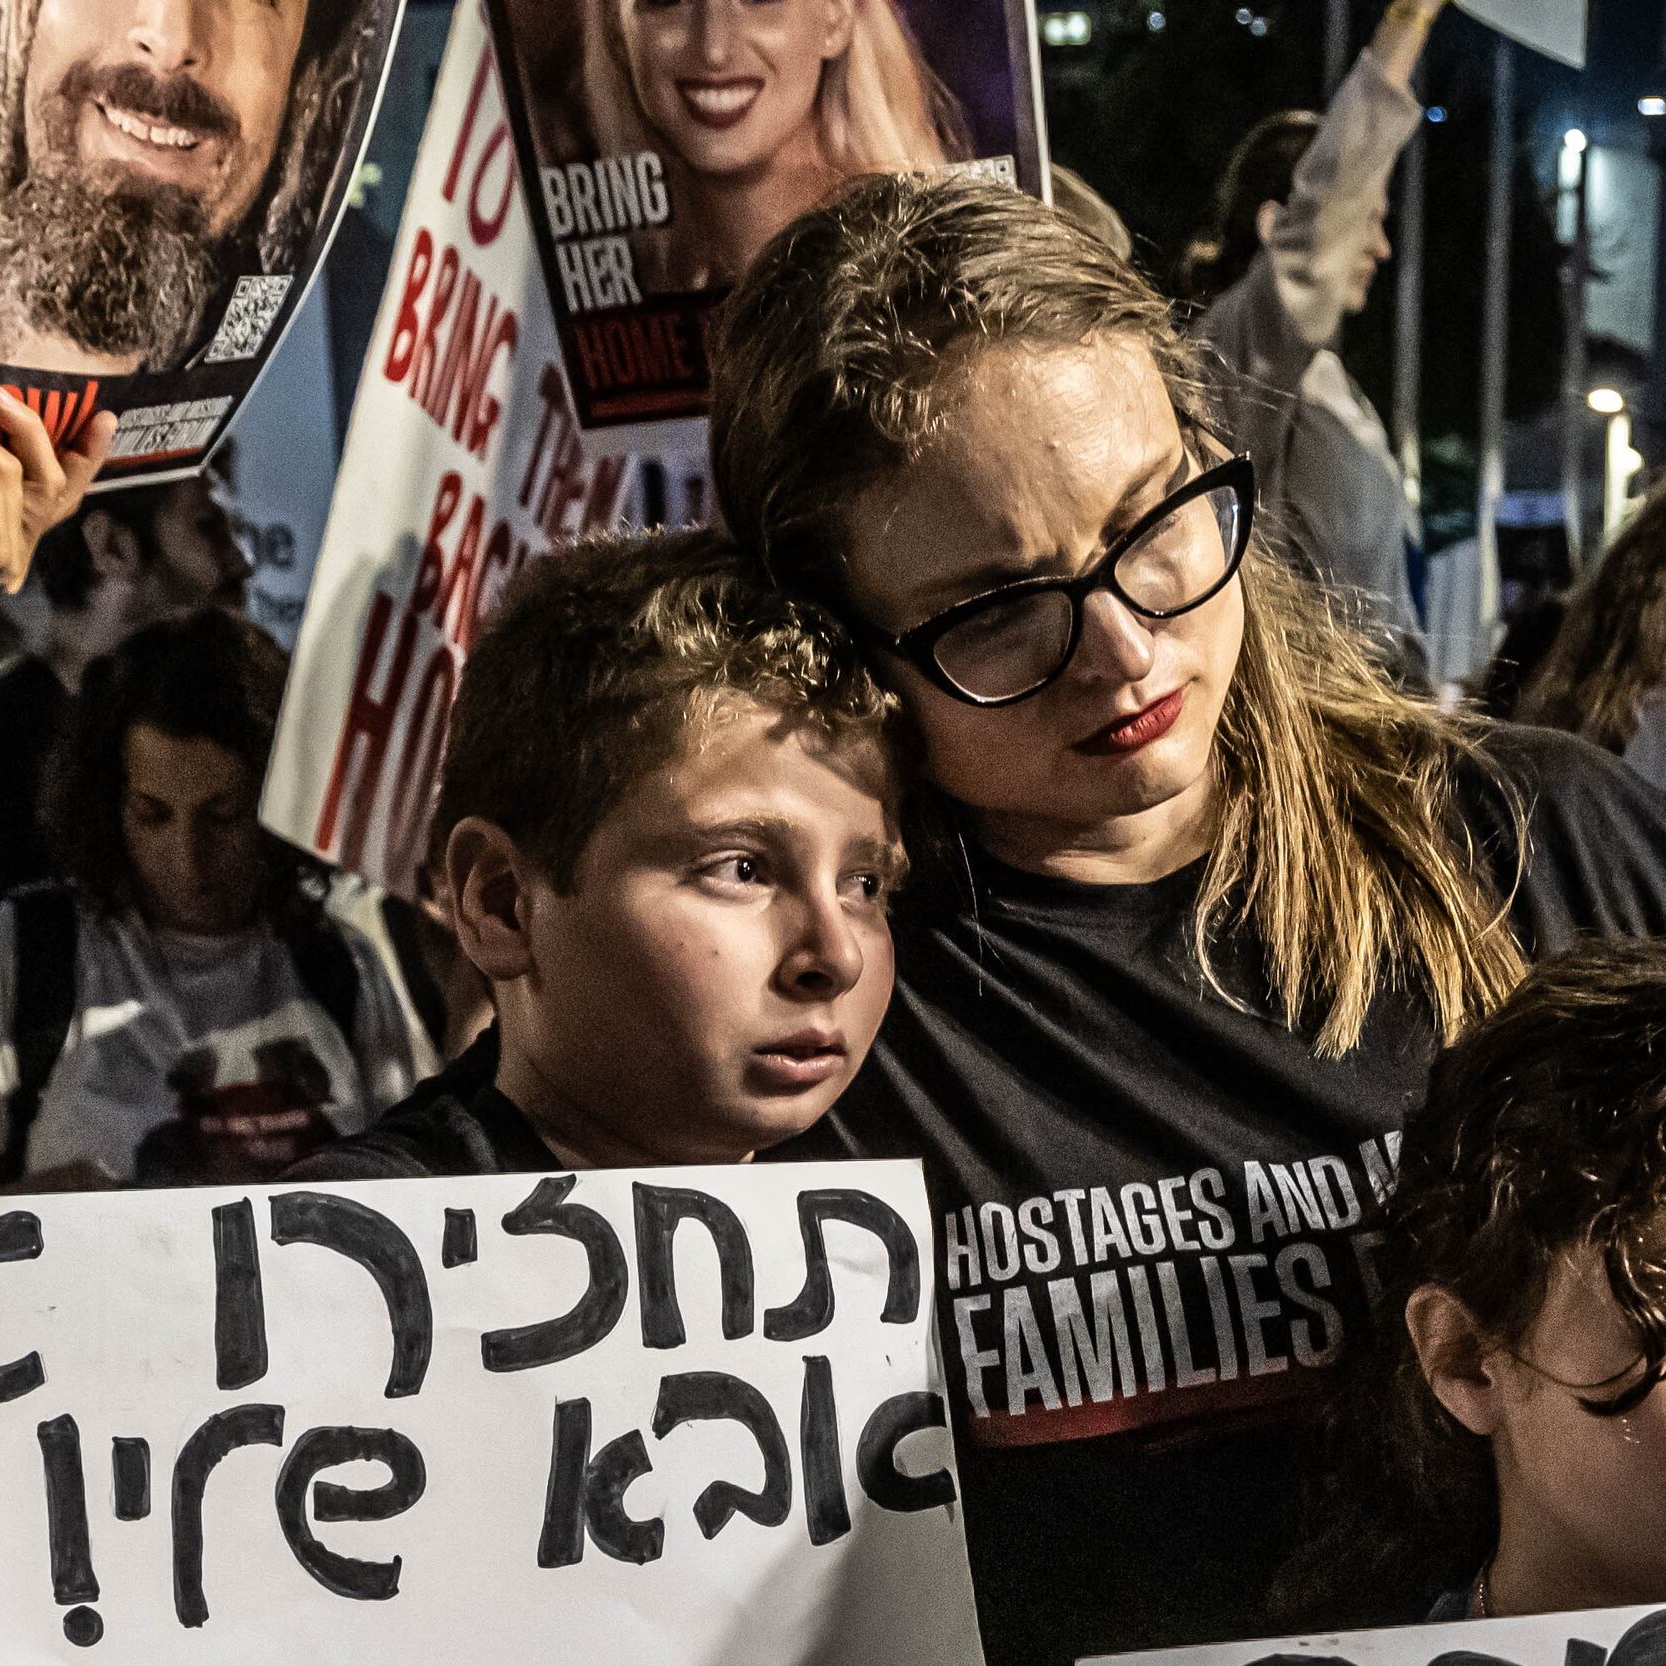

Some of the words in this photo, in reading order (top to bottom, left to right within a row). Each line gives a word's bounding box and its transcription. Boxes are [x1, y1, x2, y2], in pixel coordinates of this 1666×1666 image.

[539, 150, 671, 238] BRING
[555, 236, 643, 314] HER
[383, 226, 519, 463] BRING
[574, 312, 694, 391] HOME
[945, 1166, 1236, 1290] HOSTAGES
[1243, 1154, 1363, 1243] AND
[951, 1243, 1344, 1418] FAMILIES
[537, 1355, 958, 1568] אבא
